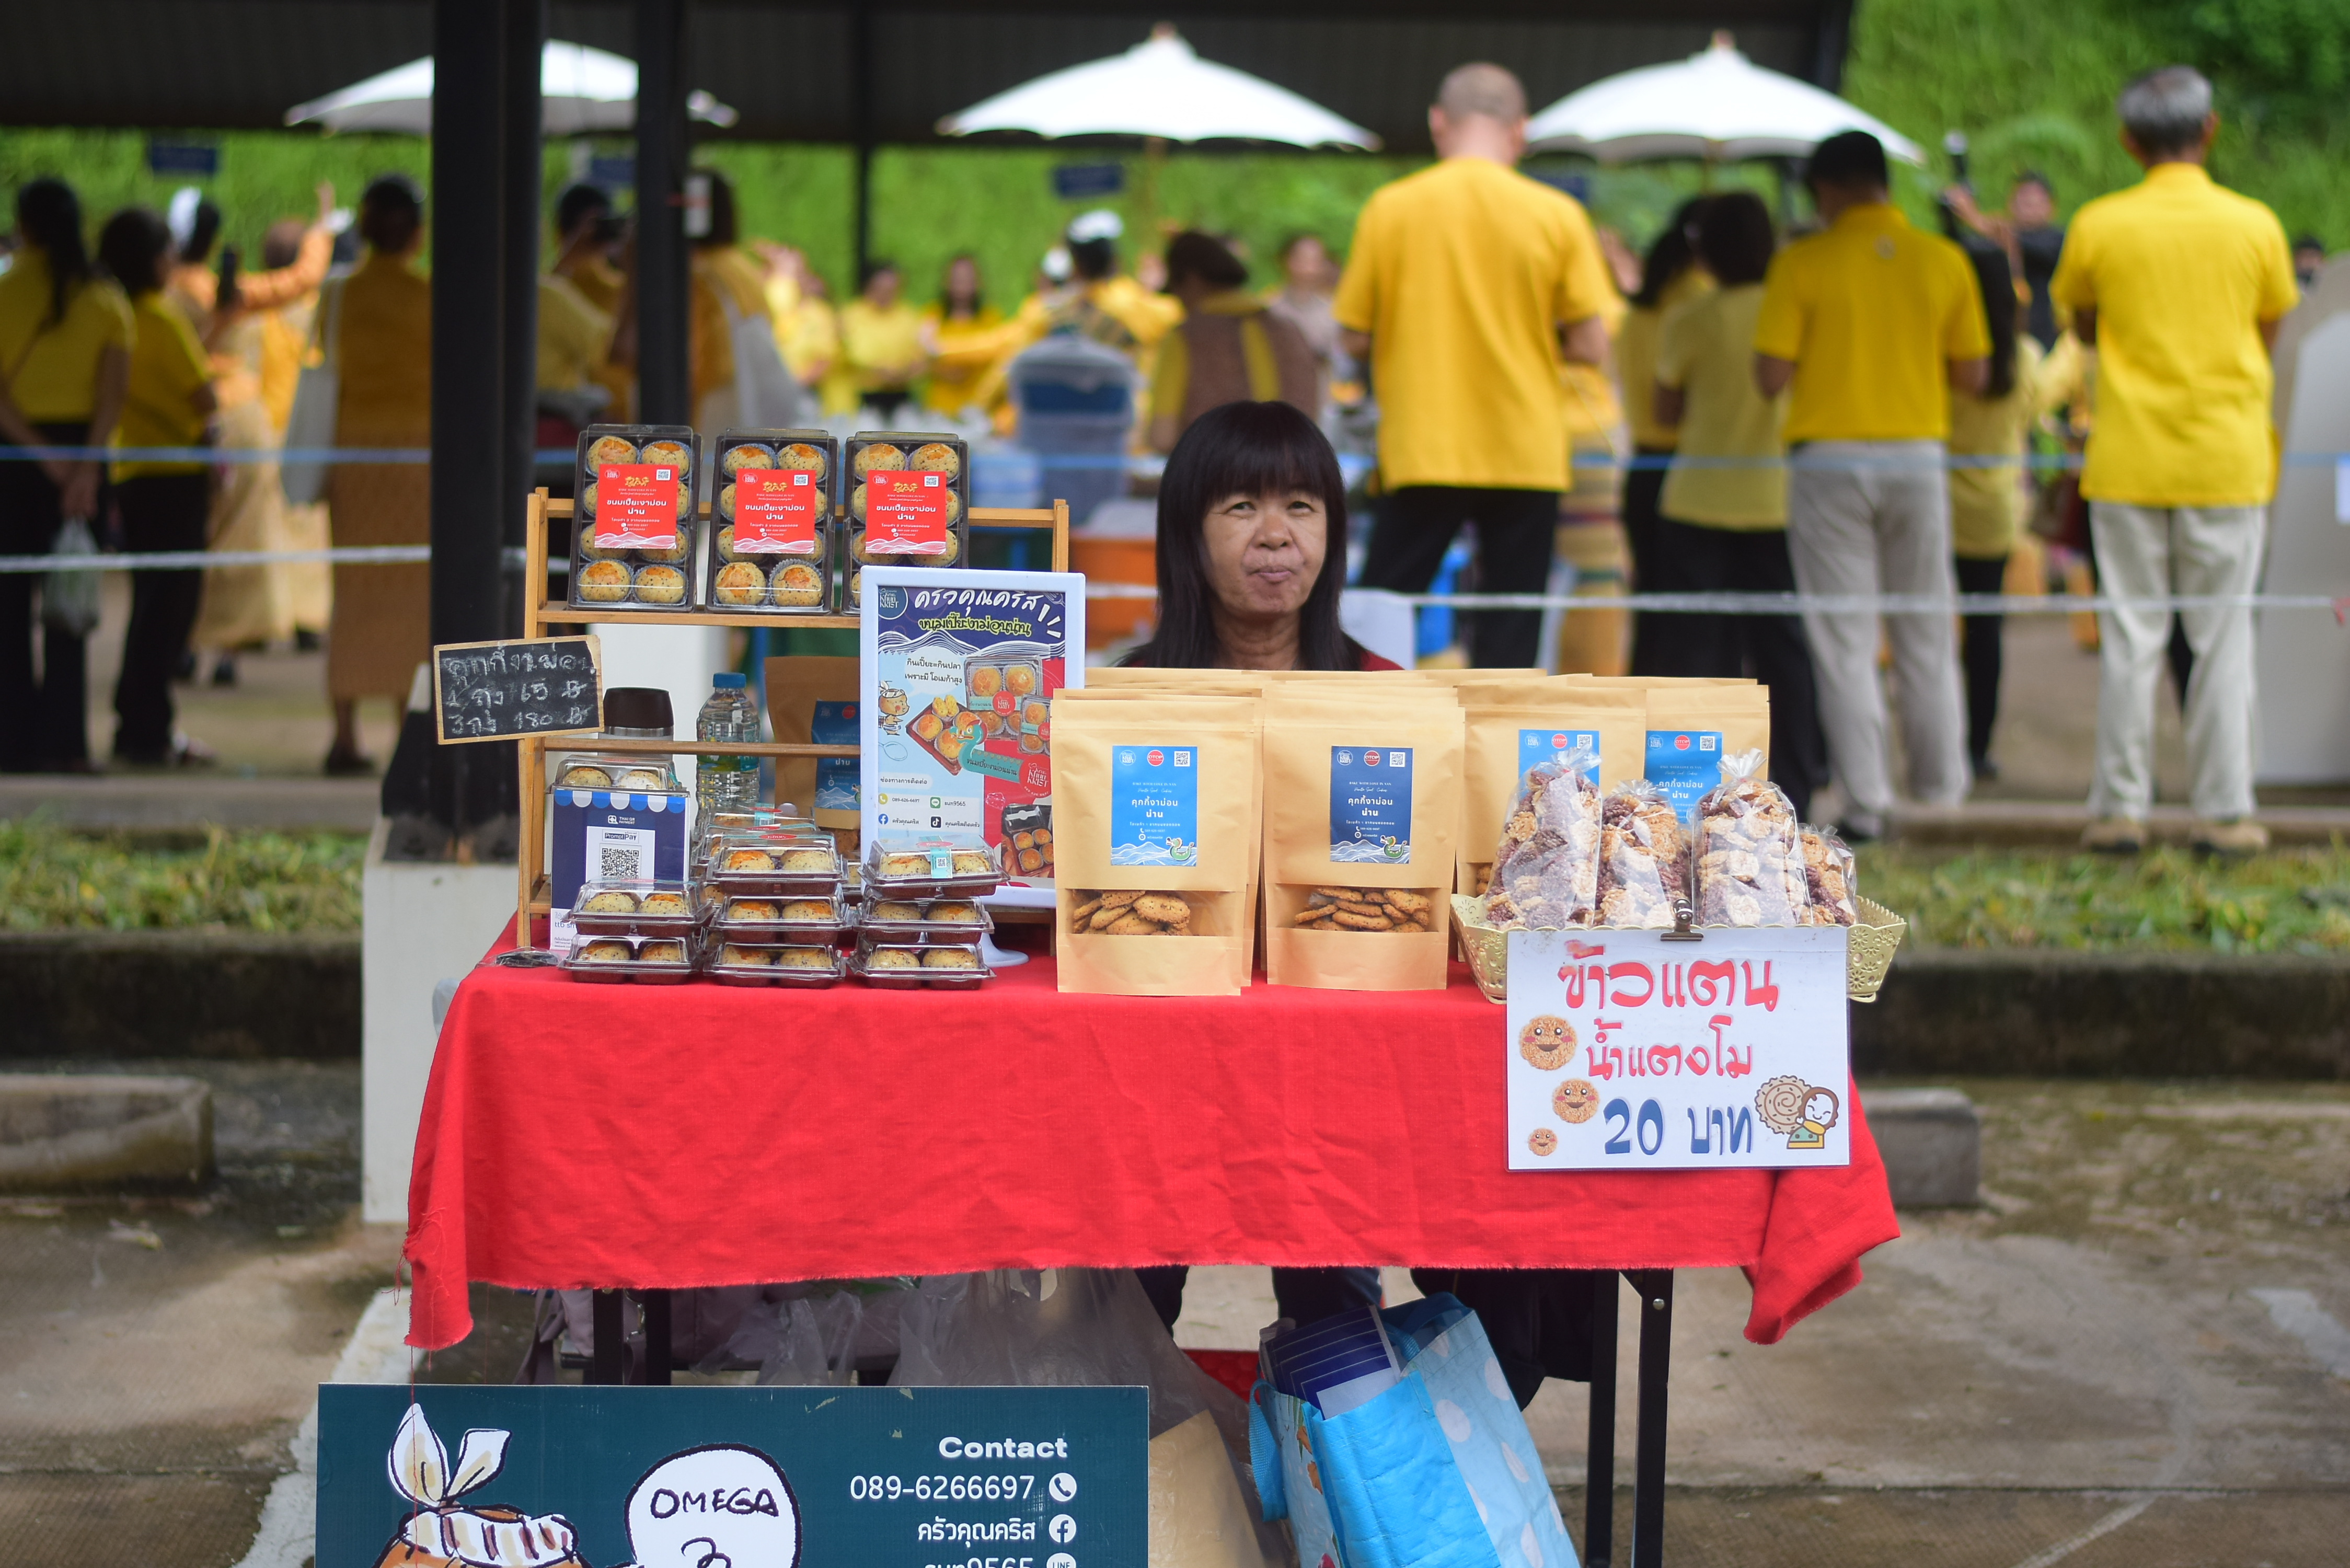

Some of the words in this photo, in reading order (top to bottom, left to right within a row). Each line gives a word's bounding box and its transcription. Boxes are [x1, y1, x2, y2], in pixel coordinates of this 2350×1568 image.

[521, 683, 548, 702] 65
[1132, 795, 1178, 808] คุกกี้งาม่อน
[1348, 795, 1393, 806] คุกกี้งาม่อน
[1672, 790, 1688, 799] น่าน
[1146, 809, 1163, 818] น่าน
[1362, 808, 1379, 816] น่าน
[1557, 939, 1779, 1012] ข้าวแตน
[1585, 1014, 1751, 1080] น้ำแตงโม
[1603, 1097, 1664, 1156] 20
[1687, 1104, 1752, 1156] บาท
[939, 1436, 1068, 1459] Contact
[850, 1475, 1035, 1500] 089-6266697
[650, 1487, 779, 1519] OMEGA
[918, 1516, 1036, 1548] ครัวคุณคริส
